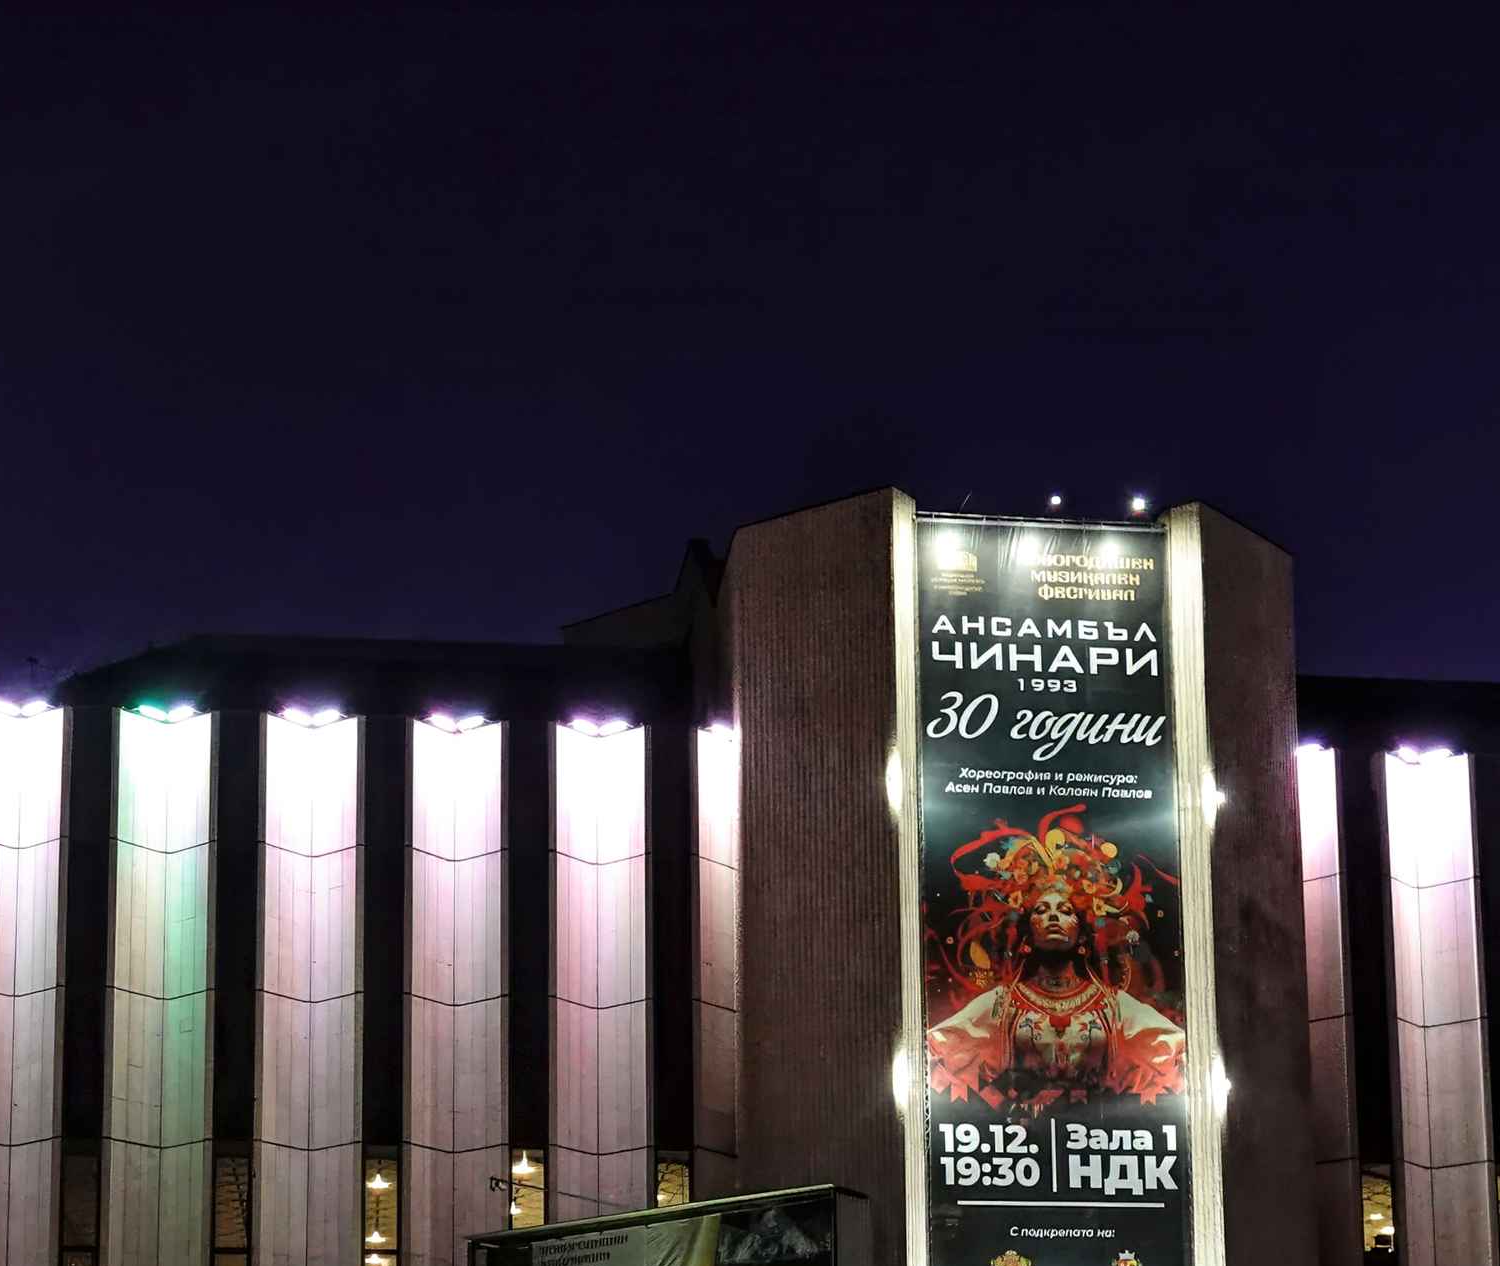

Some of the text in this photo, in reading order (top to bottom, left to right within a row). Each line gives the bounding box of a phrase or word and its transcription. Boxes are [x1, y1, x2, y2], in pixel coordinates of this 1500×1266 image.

[931, 614, 1157, 642] АНСАМБЪЛ
[931, 640, 1159, 677] ЧИНАРИ
[1017, 678, 1077, 693] 1993
[926, 691, 1166, 761] 30 години
[945, 781, 979, 794] Асен
[983, 782, 1033, 796] Павлов
[1037, 786, 1045, 796] и
[1102, 786, 1153, 799] Павлов
[958, 767, 1138, 786] Хореография и режисура:
[939, 1123, 1039, 1154] 19.12.
[1065, 1123, 1177, 1151] Зала 1
[940, 1156, 1041, 1187] 19:30
[1067, 1154, 1179, 1196] НДК
[1010, 1226, 1115, 1239] С подкрепата на:
